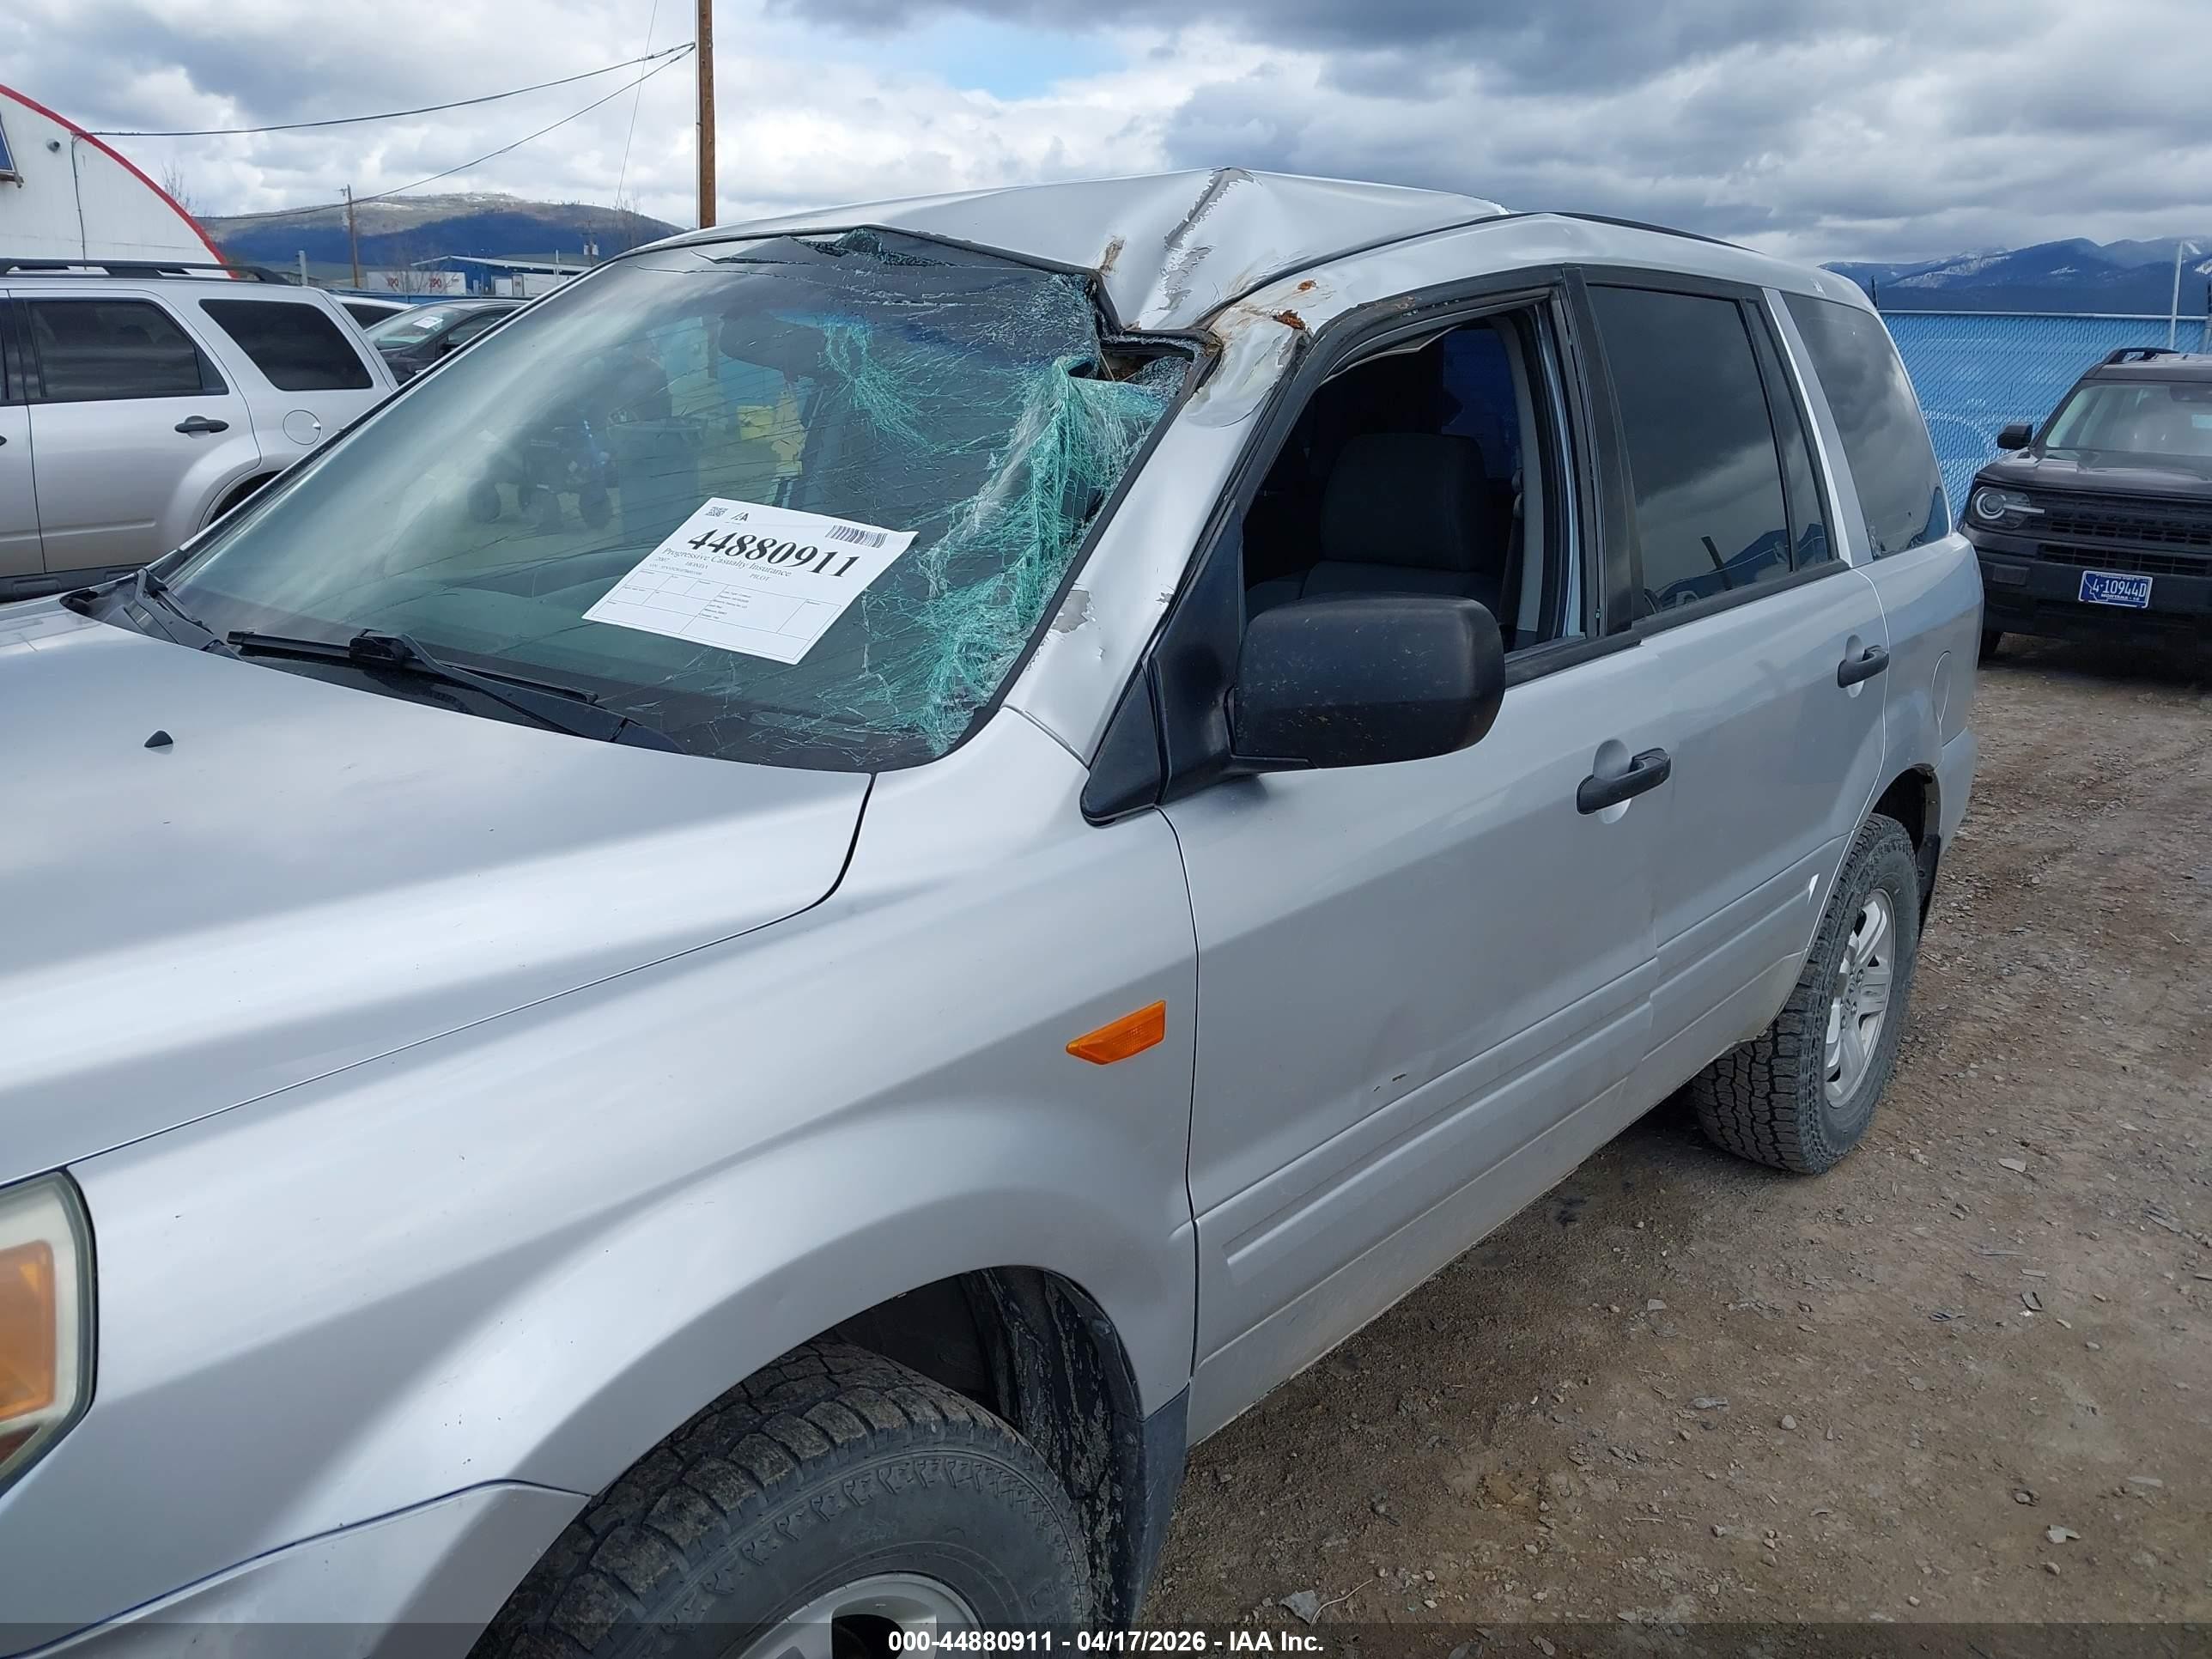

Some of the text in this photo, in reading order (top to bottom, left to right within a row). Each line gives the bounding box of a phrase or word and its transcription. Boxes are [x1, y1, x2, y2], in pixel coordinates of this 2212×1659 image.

[662, 547, 710, 562] Progressive
[711, 556, 746, 569] Casualty
[749, 562, 792, 578] Insurance
[687, 528, 860, 578] 44880911
[684, 561, 708, 569] HONDA
[749, 574, 770, 582] PILOT
